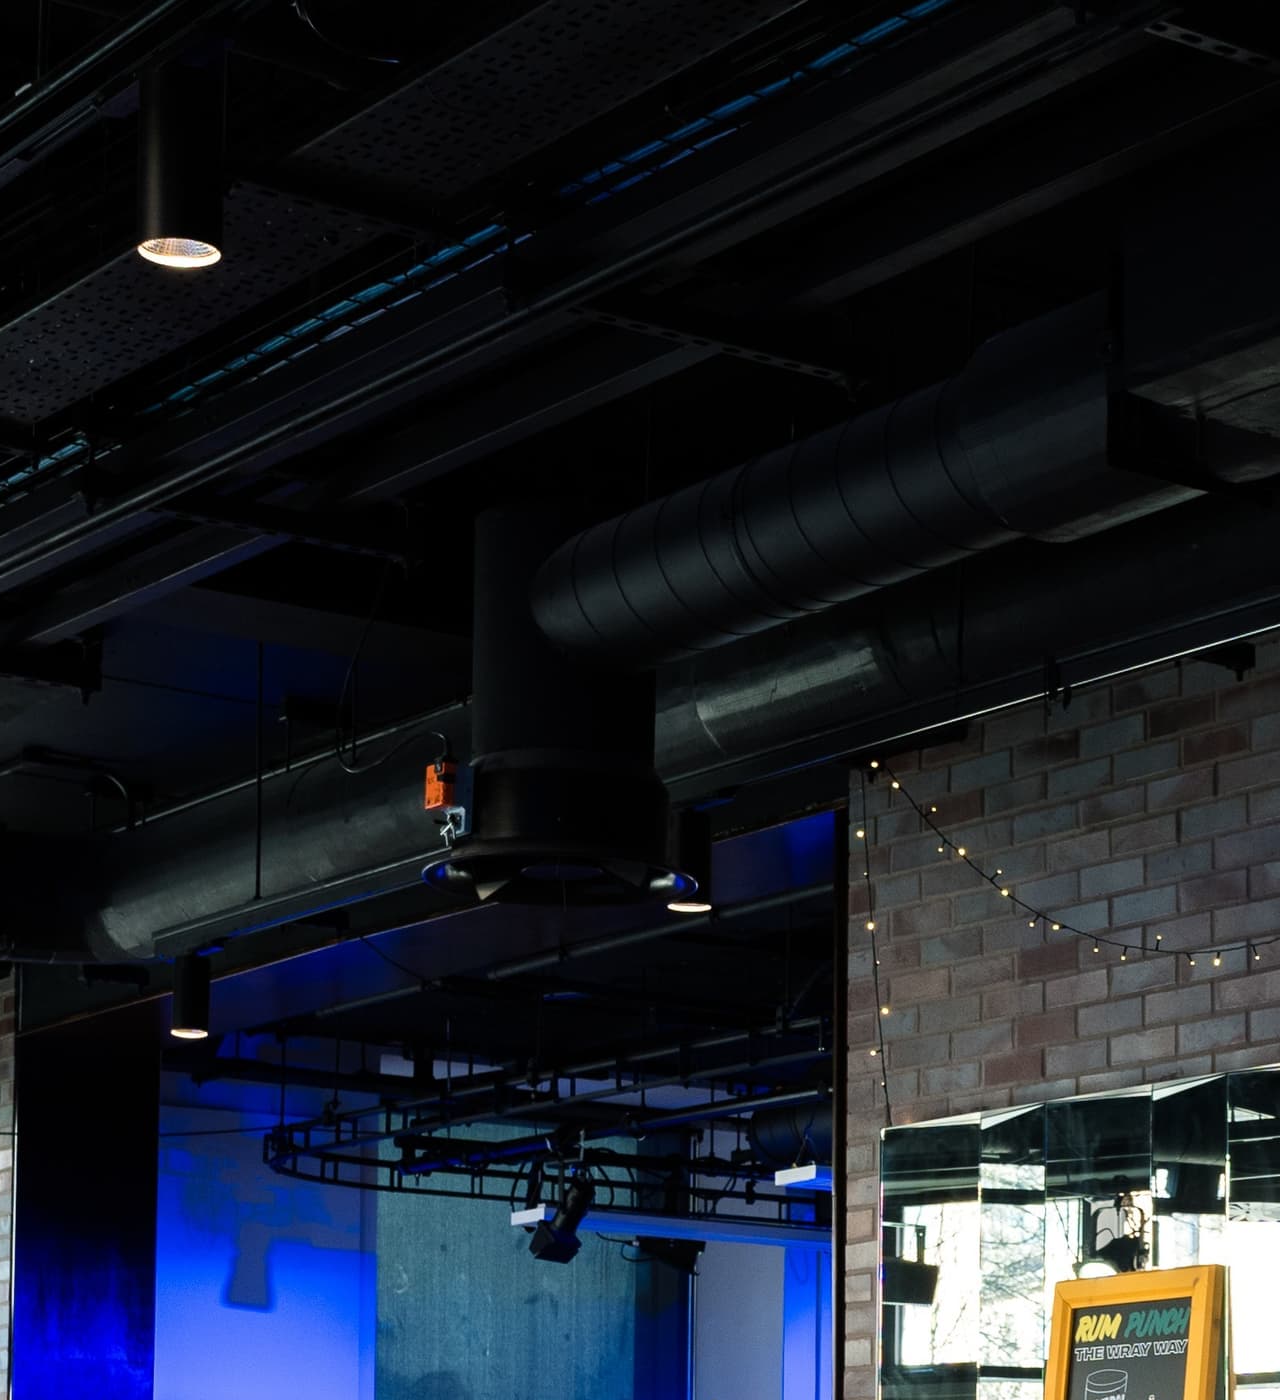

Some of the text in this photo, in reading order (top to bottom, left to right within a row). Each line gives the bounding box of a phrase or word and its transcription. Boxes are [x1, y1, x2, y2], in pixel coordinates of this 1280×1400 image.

[1075, 1306, 1191, 1343] RUM PUNCH
[1074, 1338, 1189, 1362] THE WRAY WAY
